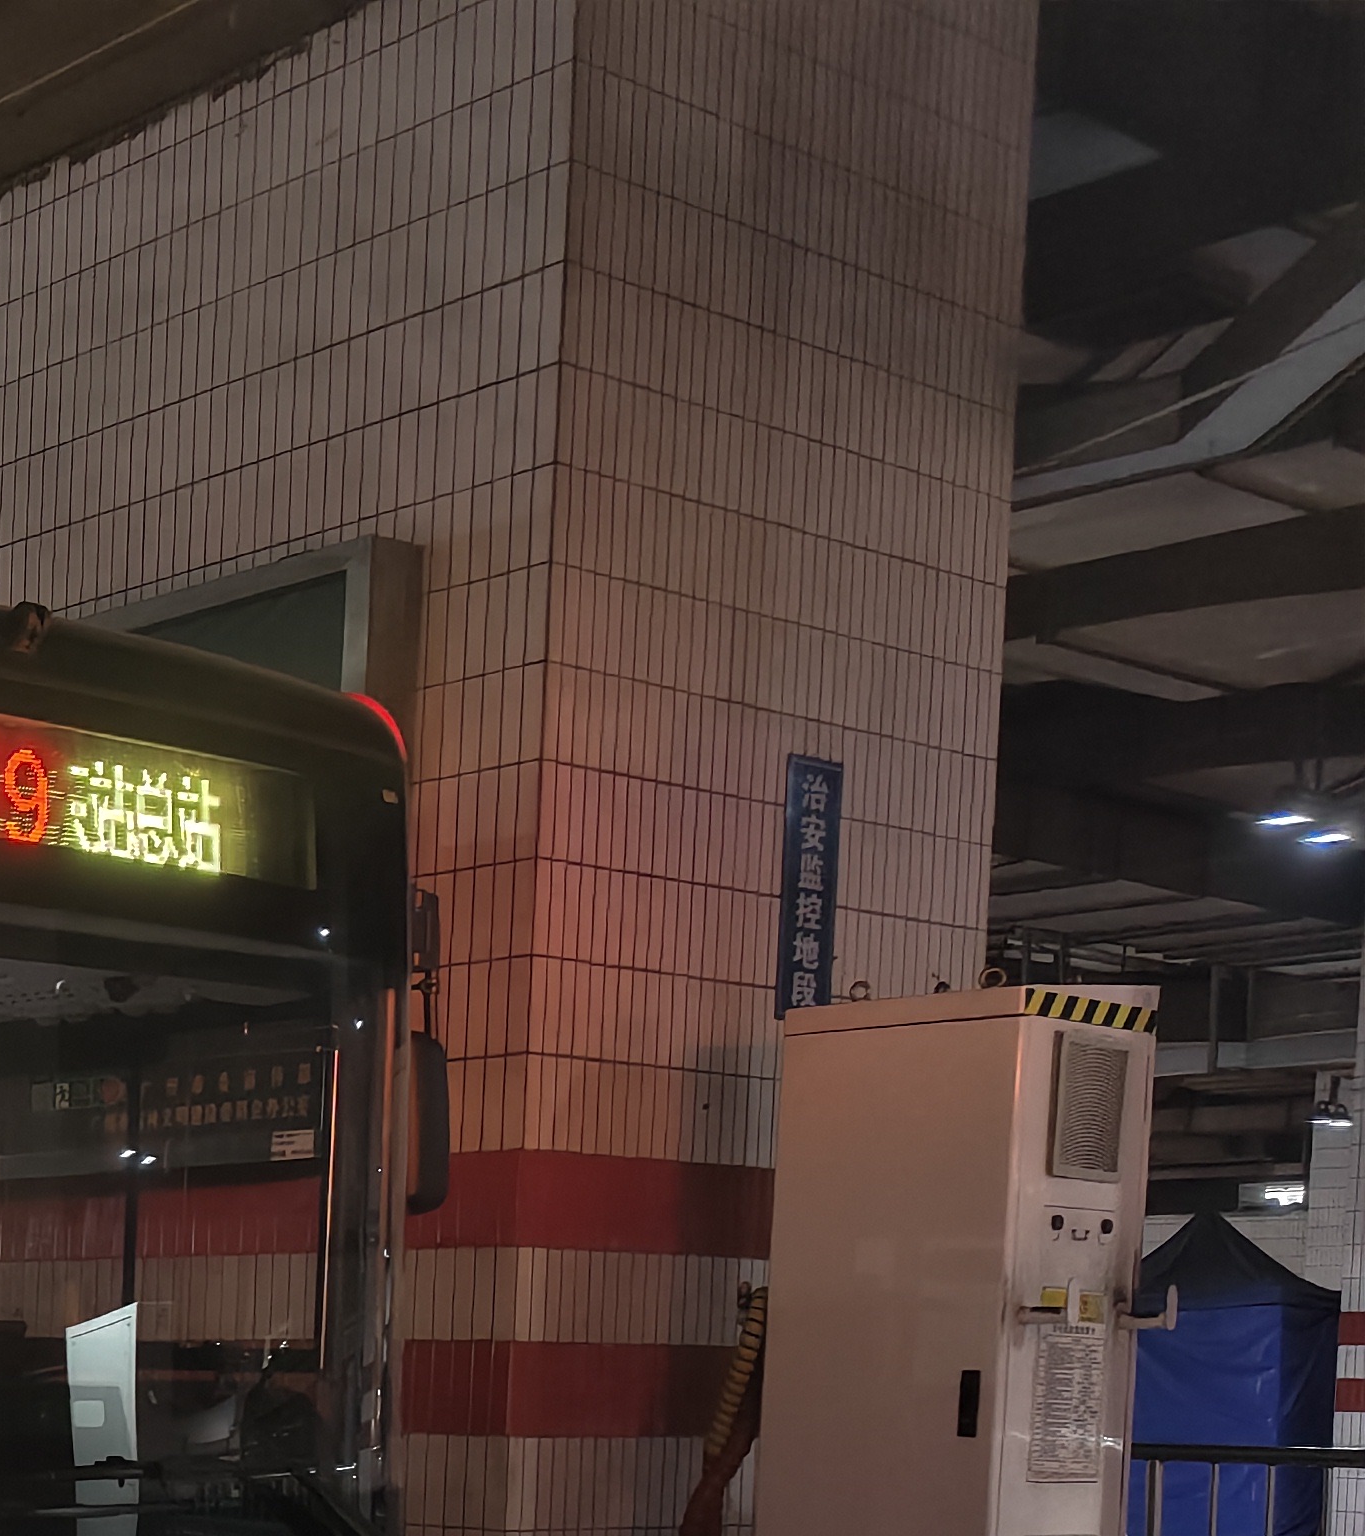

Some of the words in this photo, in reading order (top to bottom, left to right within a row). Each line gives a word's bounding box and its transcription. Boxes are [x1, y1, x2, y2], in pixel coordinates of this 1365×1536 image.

[790, 772, 831, 1007] 治安监控地段
